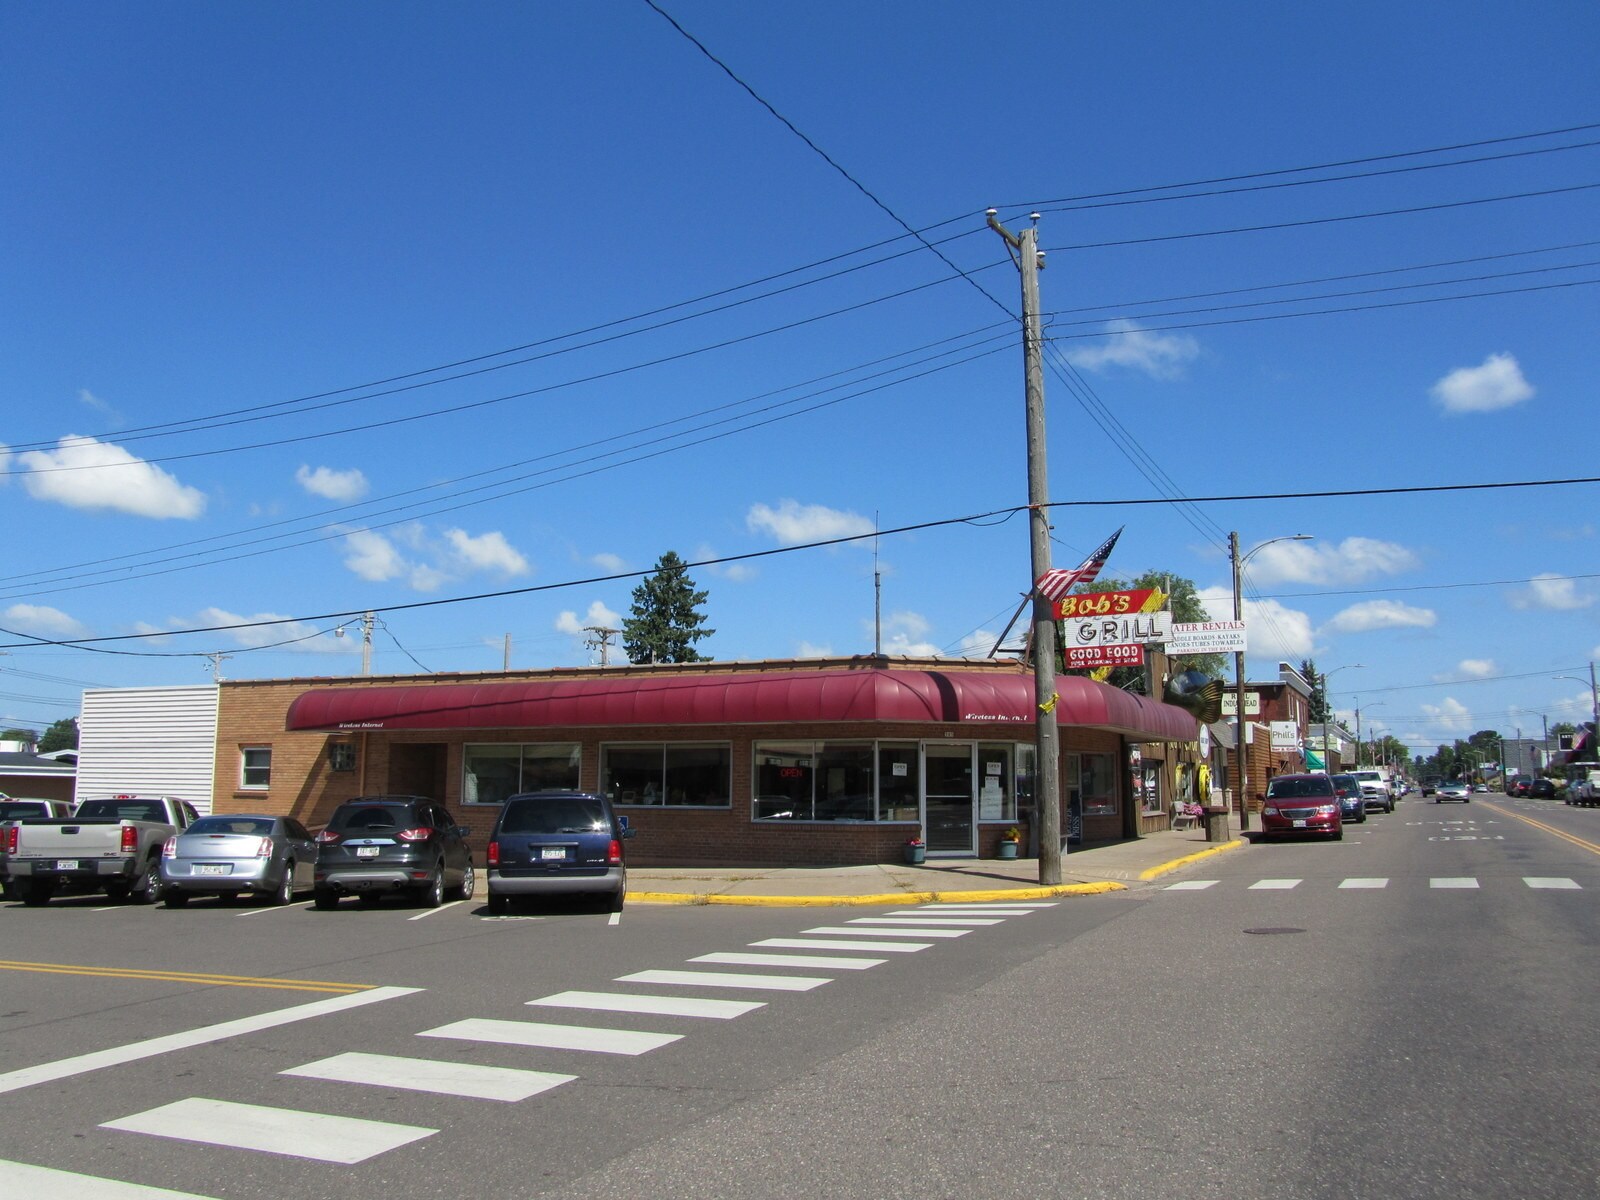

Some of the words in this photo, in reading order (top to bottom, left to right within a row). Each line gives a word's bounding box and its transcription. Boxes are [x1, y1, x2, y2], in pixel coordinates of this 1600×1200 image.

[1061, 594, 1131, 616] Bob's
[1079, 618, 1163, 641] GRILL
[1174, 623, 1198, 632] ATER
[1202, 621, 1245, 631] RENTALS
[1069, 648, 1101, 660] GOOD
[1106, 645, 1138, 658] FOOD
[781, 768, 803, 777] OPEN
